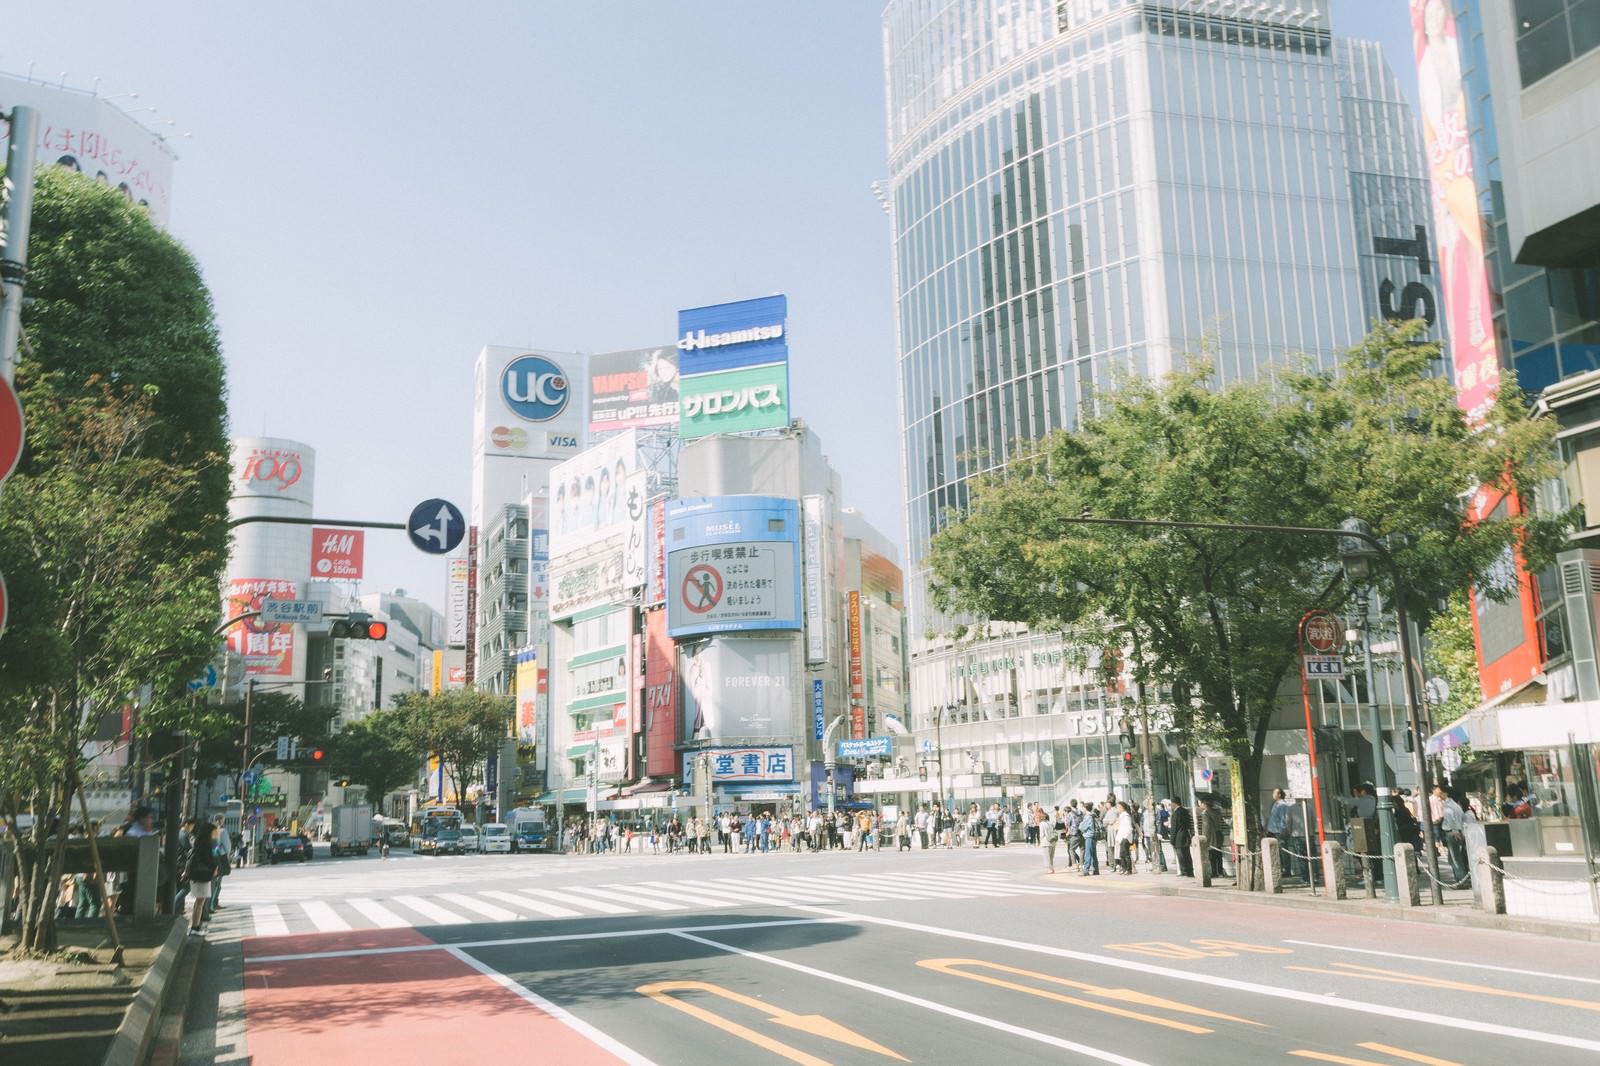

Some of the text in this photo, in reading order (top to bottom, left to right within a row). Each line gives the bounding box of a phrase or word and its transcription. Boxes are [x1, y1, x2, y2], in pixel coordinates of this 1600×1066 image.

[676, 324, 783, 351] Hisamitsu
[507, 370, 565, 406] UC
[682, 383, 781, 418] サロンパス
[550, 435, 577, 448] VISA
[240, 455, 303, 491] 109
[321, 534, 353, 554] H&M
[626, 485, 644, 582] もんじゃ
[690, 546, 760, 564] 歩行喫煙禁止
[333, 566, 357, 575] 150m
[266, 602, 320, 615] 渋谷駅前
[450, 580, 465, 644] Essential
[1310, 662, 1339, 673] KEN
[725, 676, 786, 688] FOREVER 21
[686, 753, 787, 777] 堂書店
